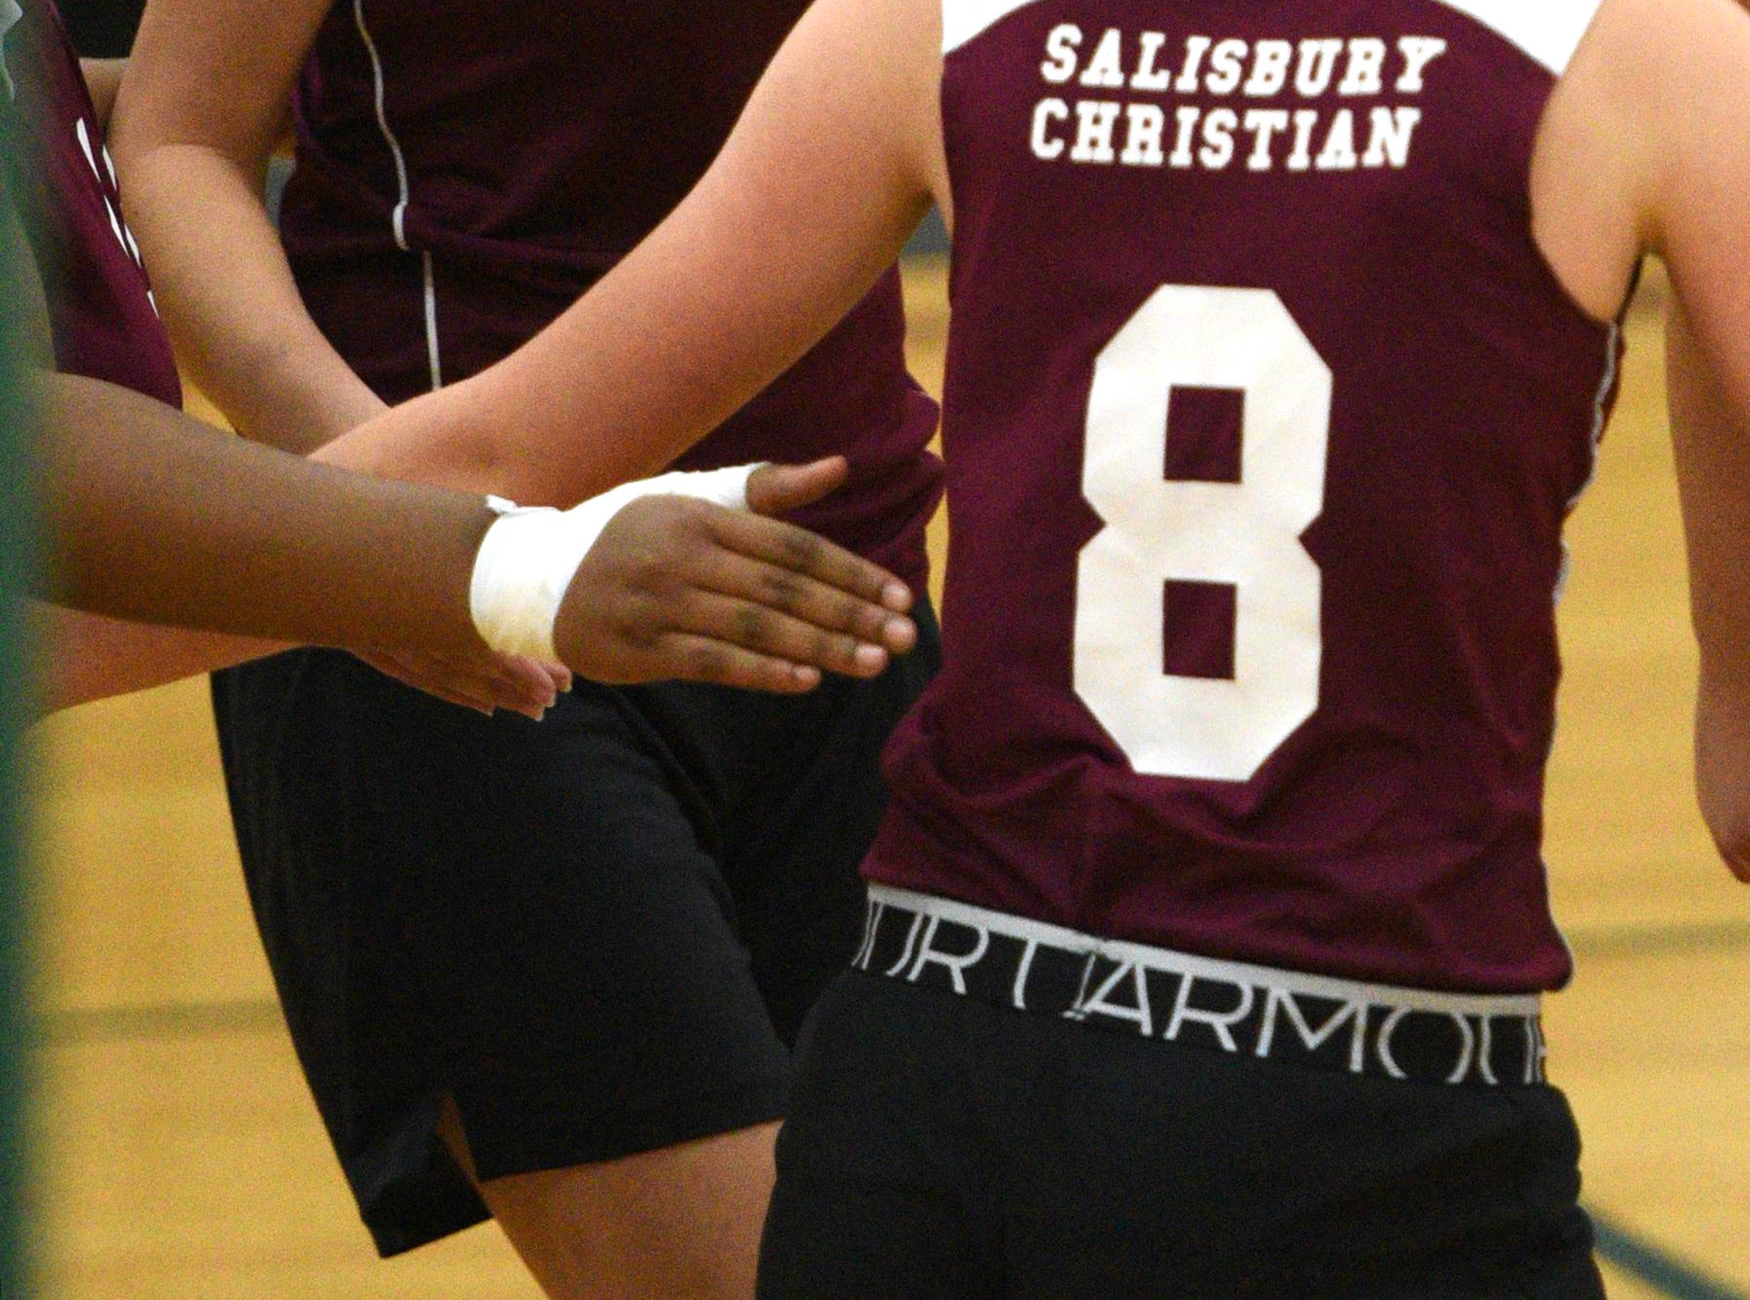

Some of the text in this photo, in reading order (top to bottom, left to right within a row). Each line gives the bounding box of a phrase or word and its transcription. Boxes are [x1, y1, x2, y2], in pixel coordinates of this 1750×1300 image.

[1040, 22, 1448, 98] SALISBURY
[1029, 97, 1422, 172] CHRISTIAN
[1073, 283, 1334, 783] 8
